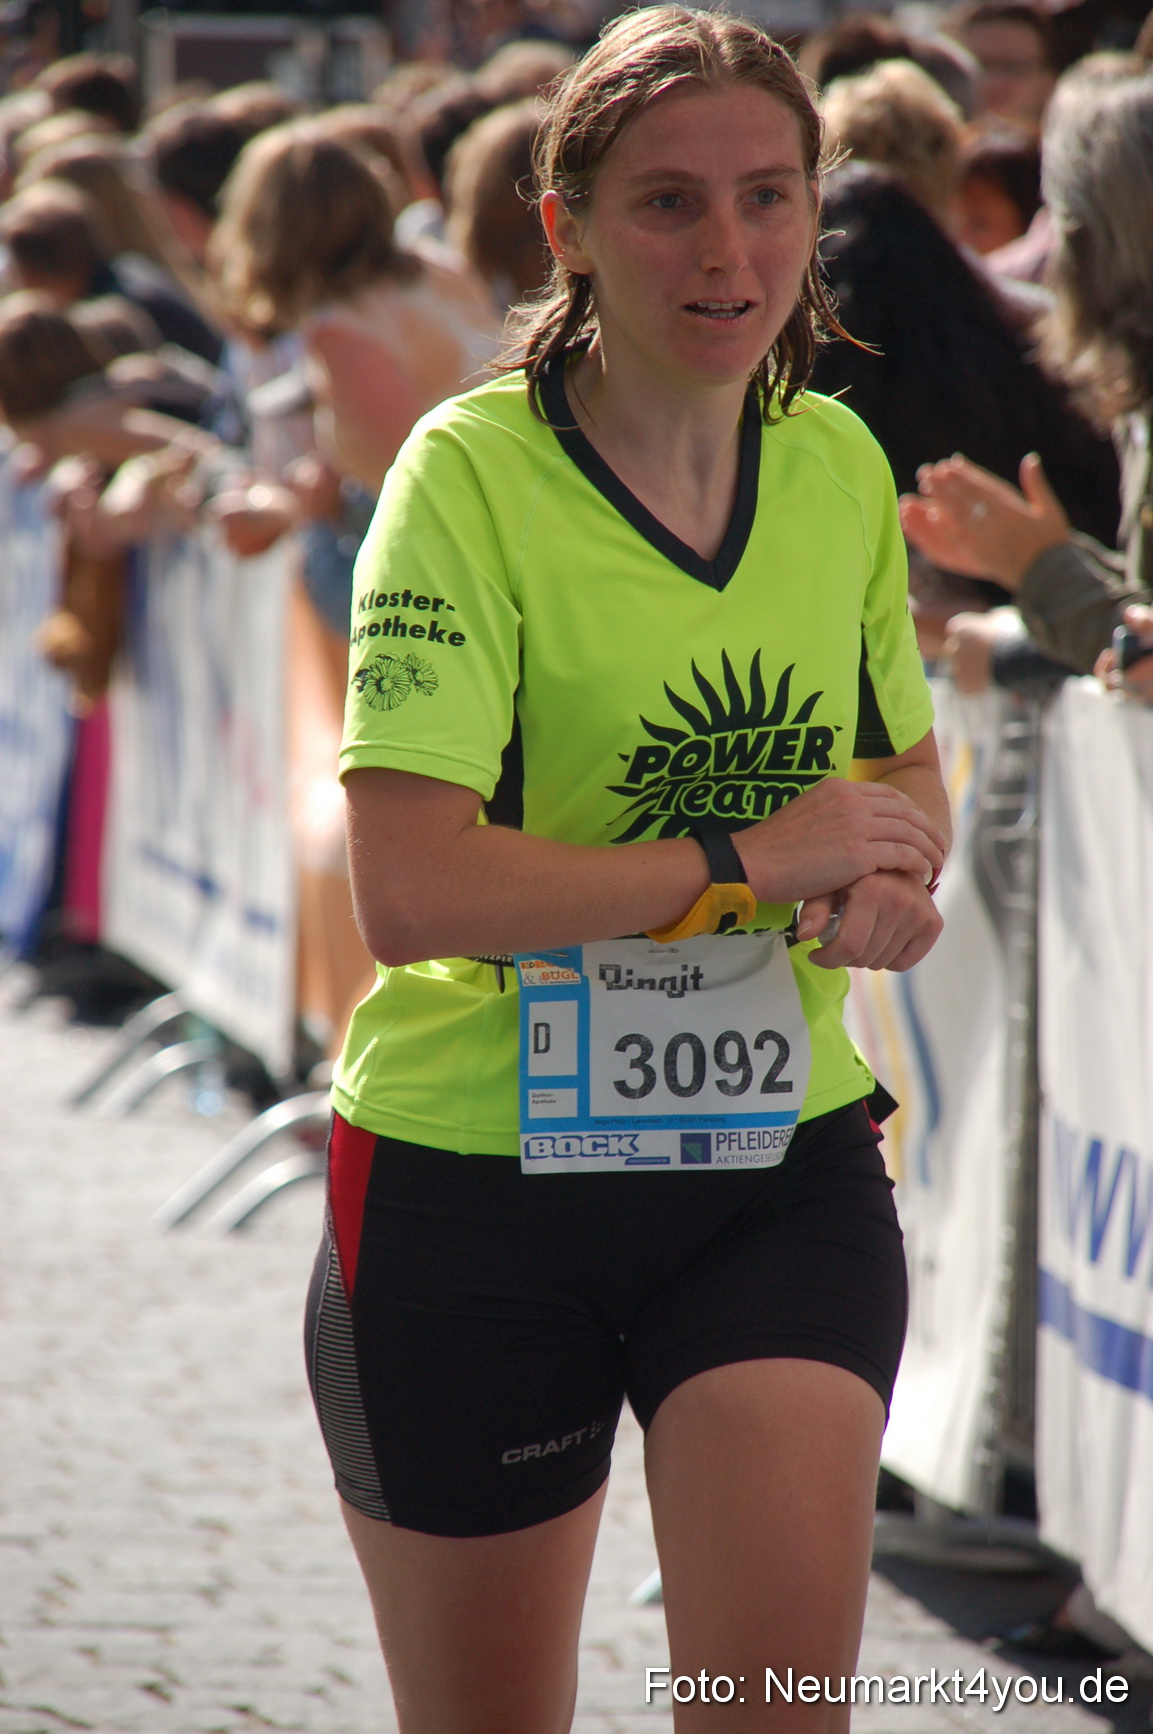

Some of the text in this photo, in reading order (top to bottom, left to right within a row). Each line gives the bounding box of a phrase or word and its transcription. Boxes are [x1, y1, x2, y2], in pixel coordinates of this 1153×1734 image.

[357, 588, 456, 614] Kloster-
[623, 724, 836, 786] POWER
[649, 776, 803, 820] Team
[532, 1022, 551, 1054] D
[612, 1029, 794, 1100] 3092
[524, 1133, 640, 1160] BOCK
[716, 1126, 795, 1152] PFLEIDERE
[501, 1427, 588, 1466] CRAFT
